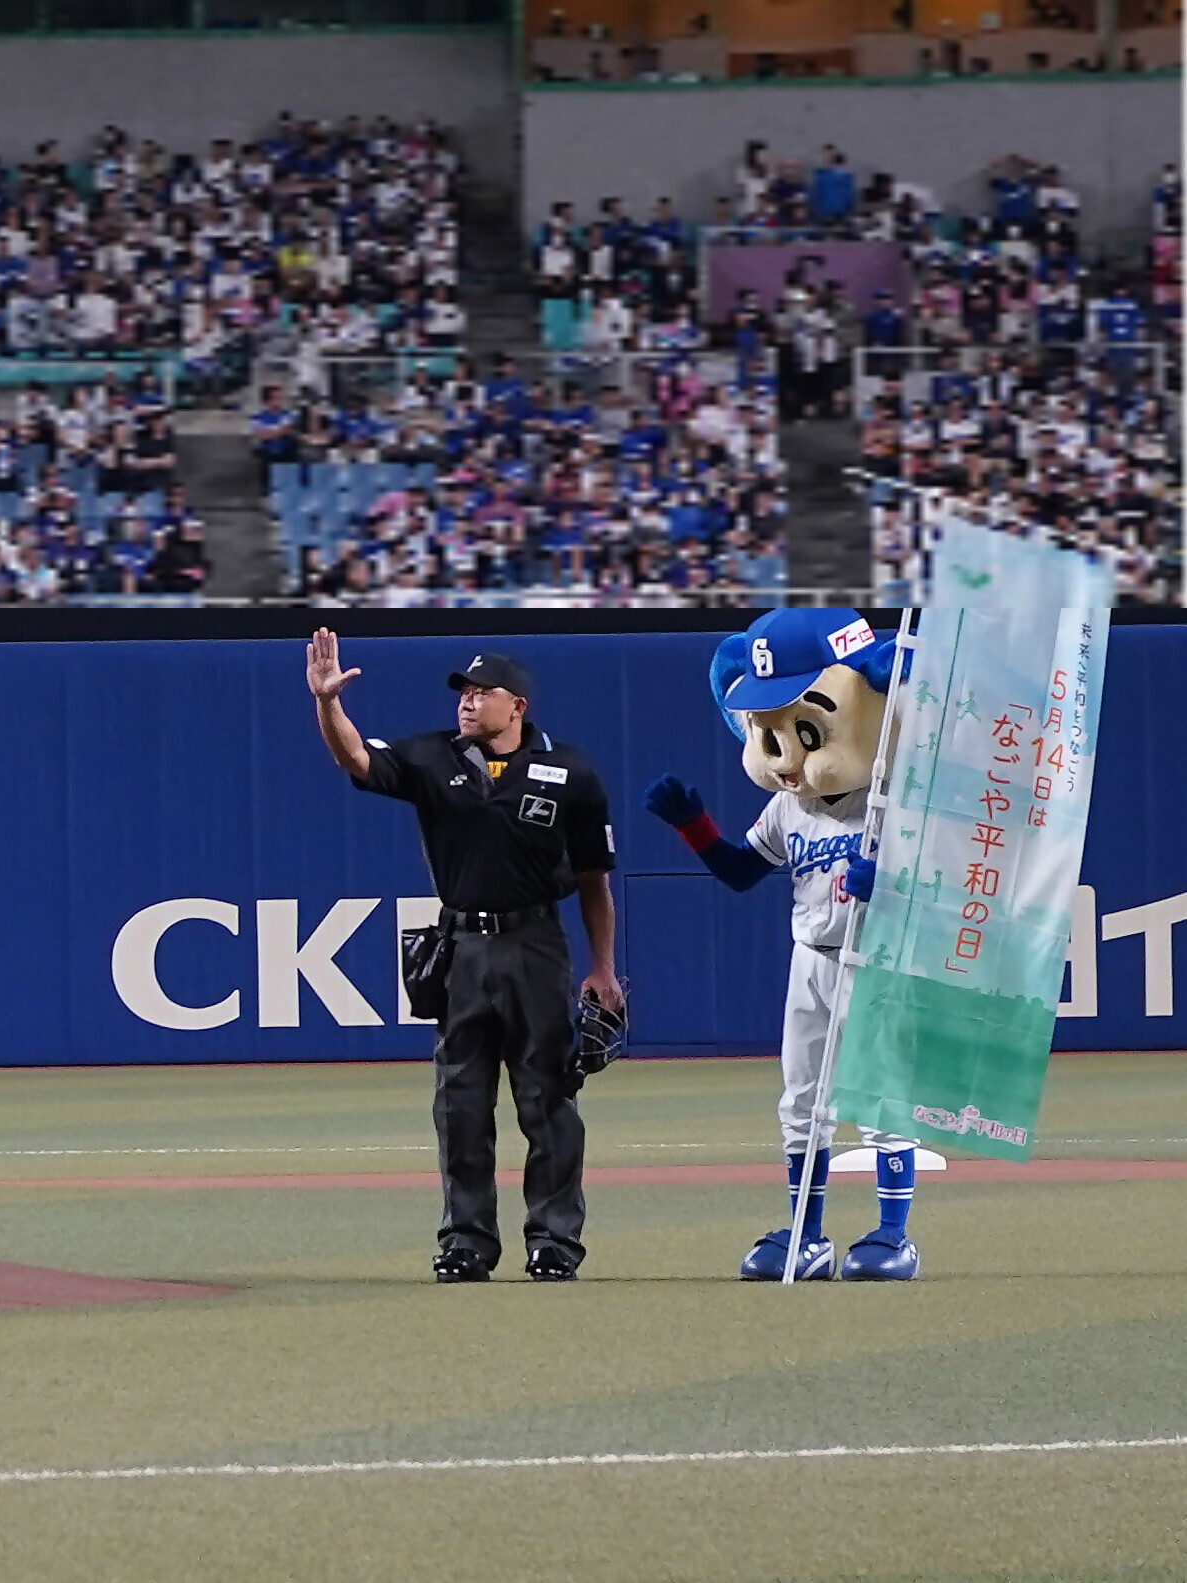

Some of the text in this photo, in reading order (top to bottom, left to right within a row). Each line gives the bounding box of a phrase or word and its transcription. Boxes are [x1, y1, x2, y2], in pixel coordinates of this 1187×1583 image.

[1027, 669, 1068, 828] 5月14日は
[788, 832, 879, 876] Dragon
